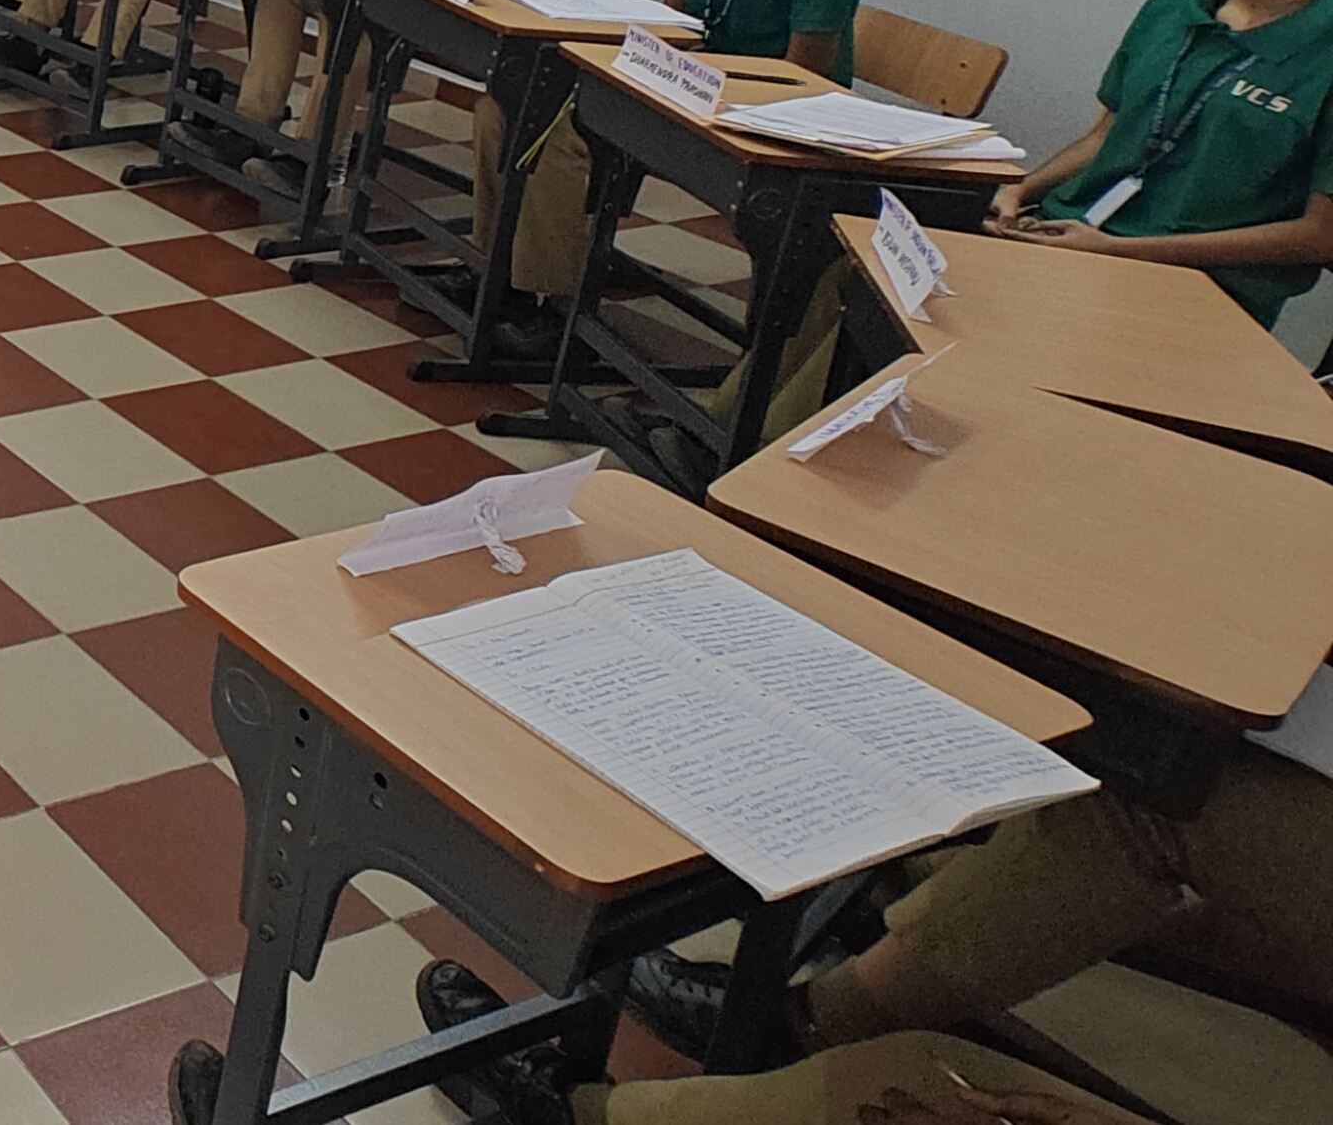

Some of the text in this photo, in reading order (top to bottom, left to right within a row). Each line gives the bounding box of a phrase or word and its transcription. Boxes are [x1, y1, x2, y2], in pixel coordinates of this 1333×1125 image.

[627, 28, 660, 55] MINISTER
[678, 57, 722, 91] EDUCATION
[1230, 79, 1293, 113] VCS
